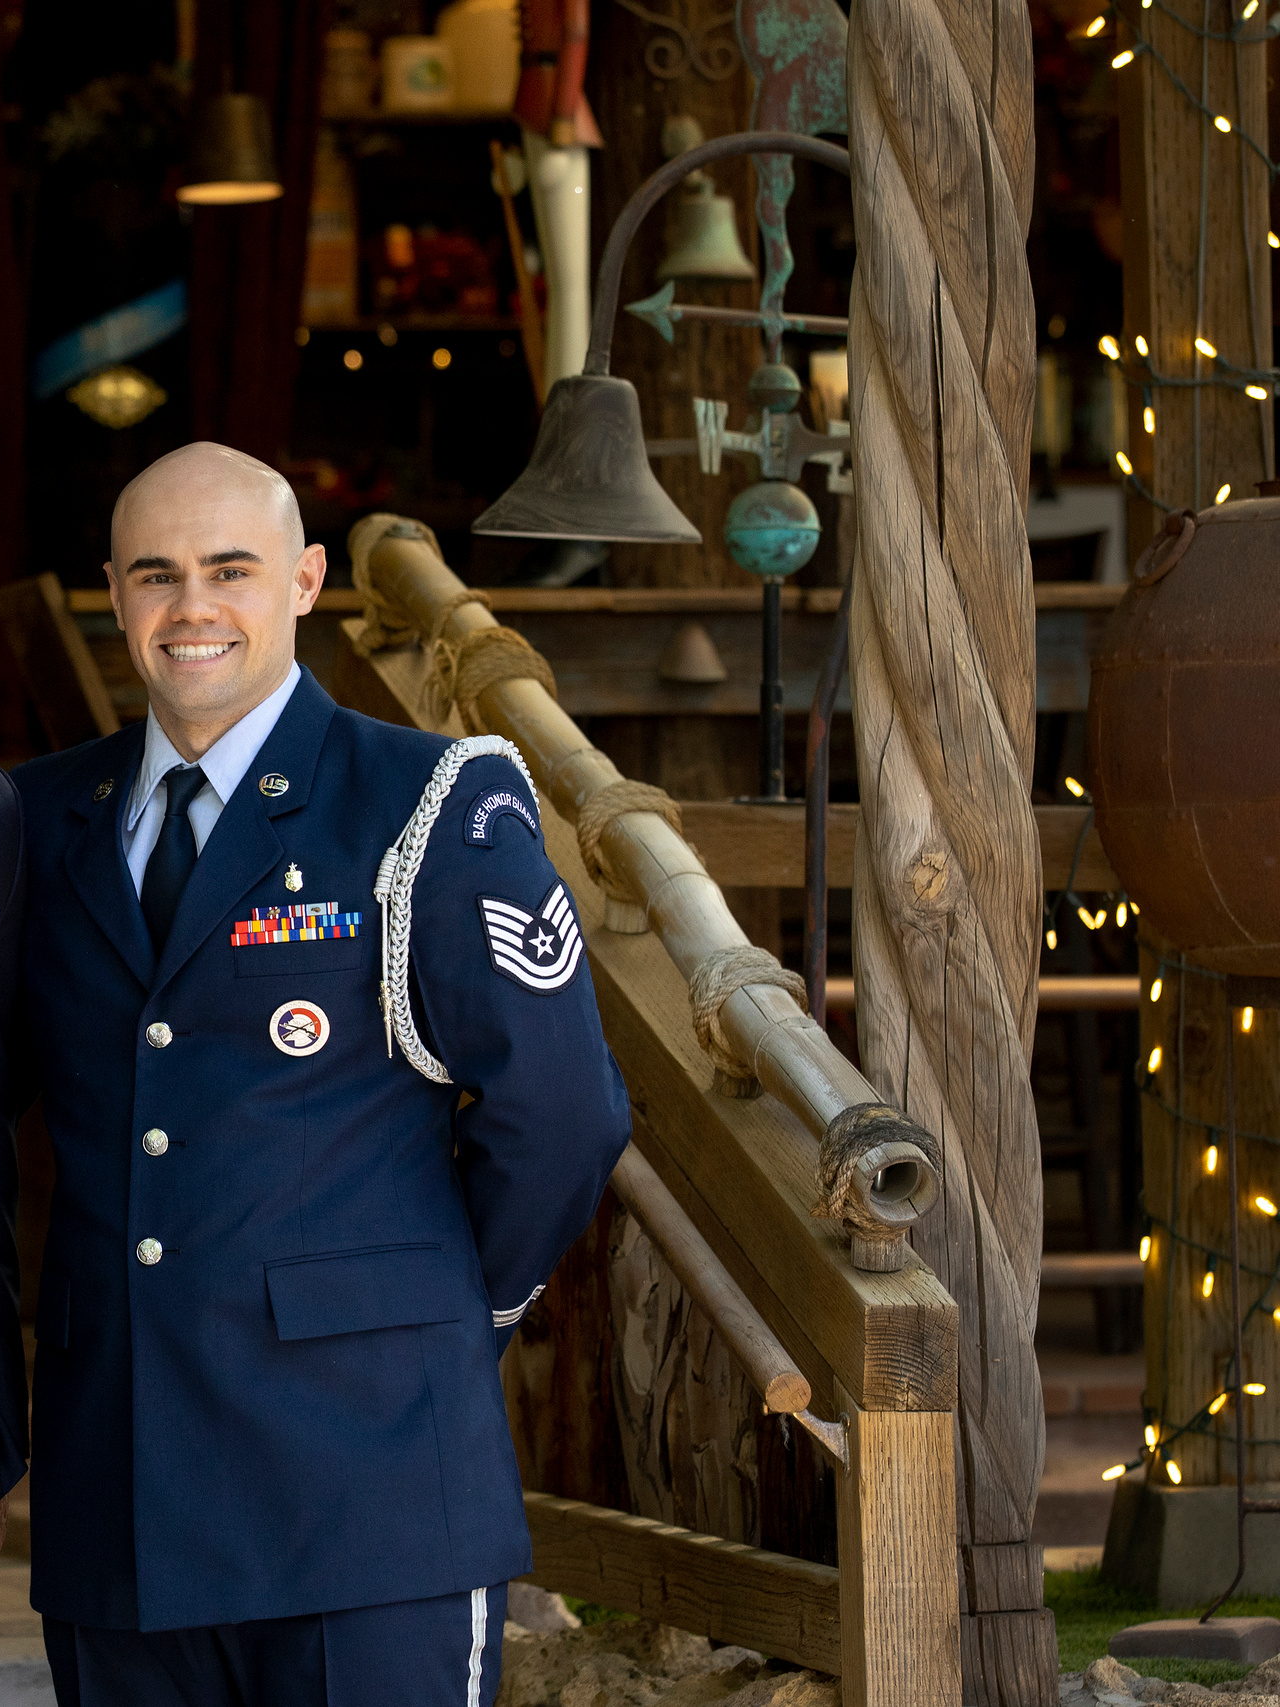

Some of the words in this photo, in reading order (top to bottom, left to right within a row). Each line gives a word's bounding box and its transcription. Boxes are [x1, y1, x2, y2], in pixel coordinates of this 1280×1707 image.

[472, 807, 489, 839] BASE
[482, 792, 512, 814] HONOR
[512, 796, 536, 829] GUARD
